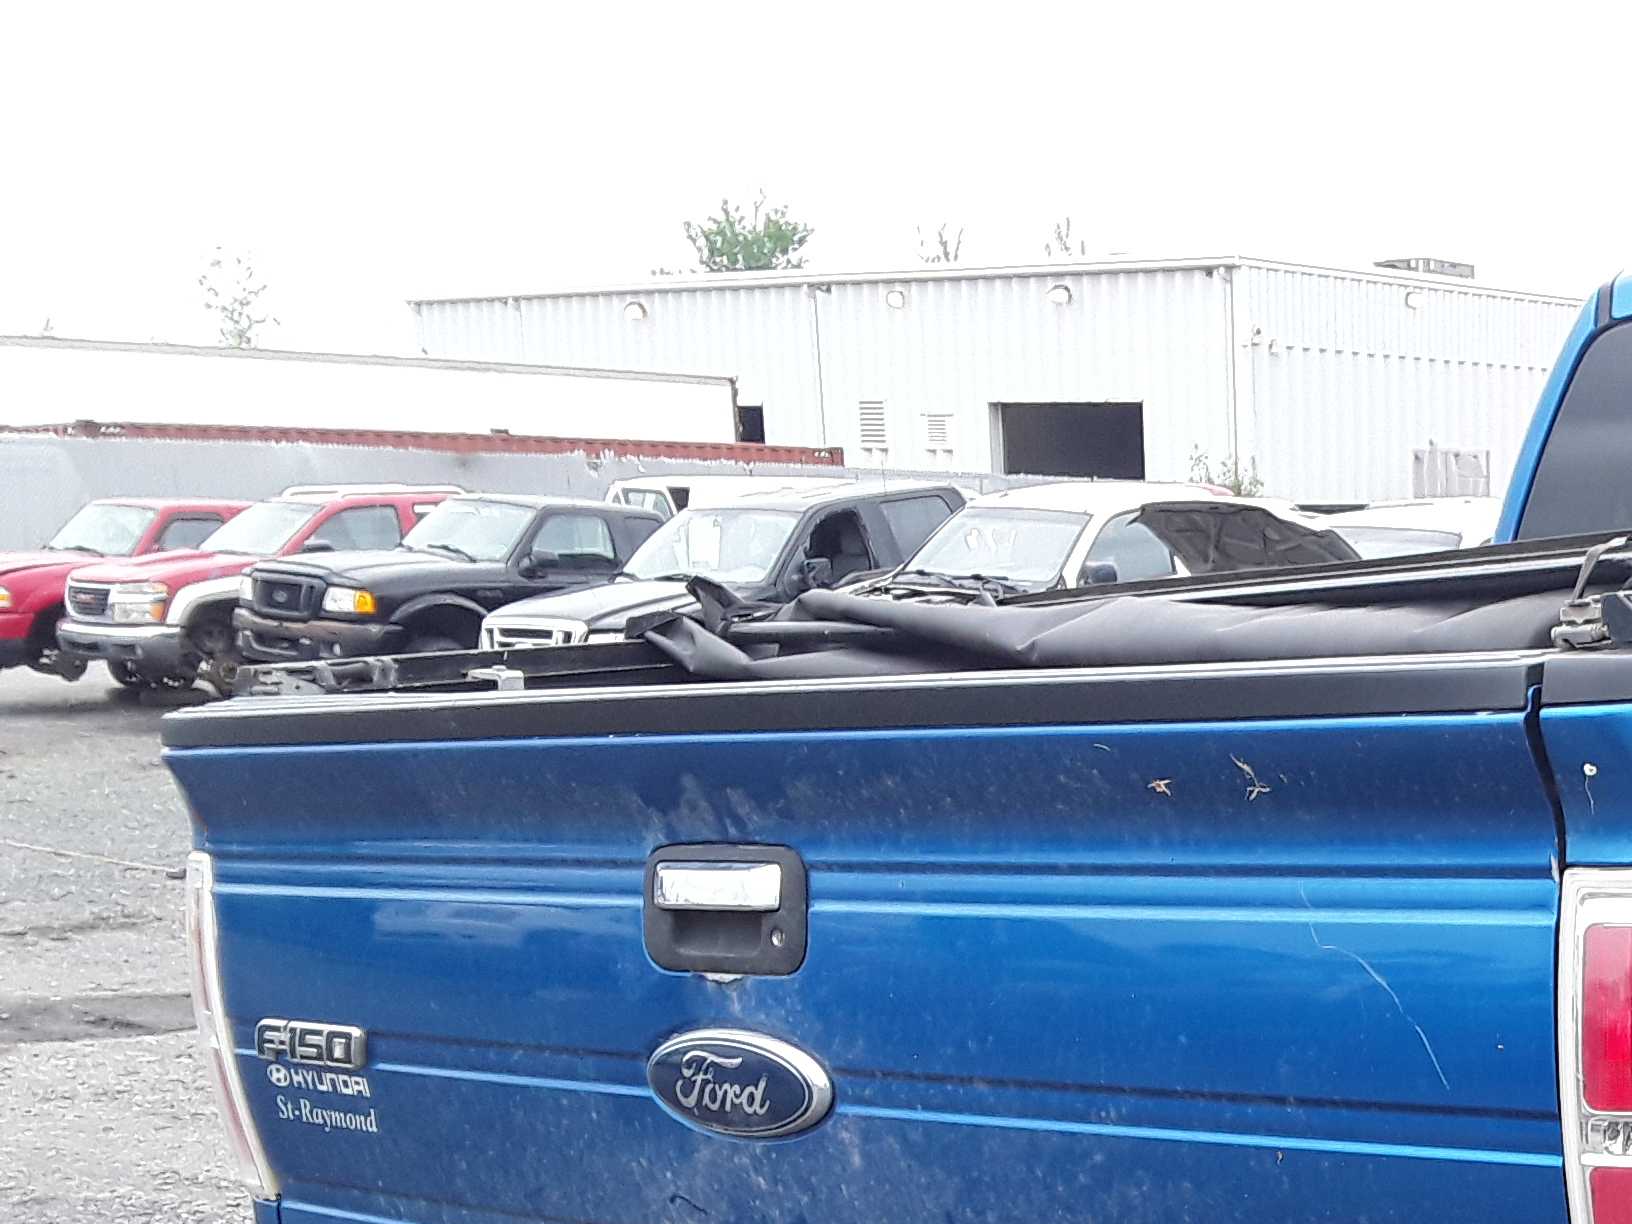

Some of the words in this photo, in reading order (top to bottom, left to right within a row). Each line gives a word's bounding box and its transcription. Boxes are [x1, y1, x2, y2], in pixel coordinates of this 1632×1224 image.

[255, 1019, 364, 1070] F-150
[290, 1069, 371, 1098] HYUNDAI
[675, 1050, 770, 1115] Ford
[276, 1095, 379, 1133] St-Raymond
